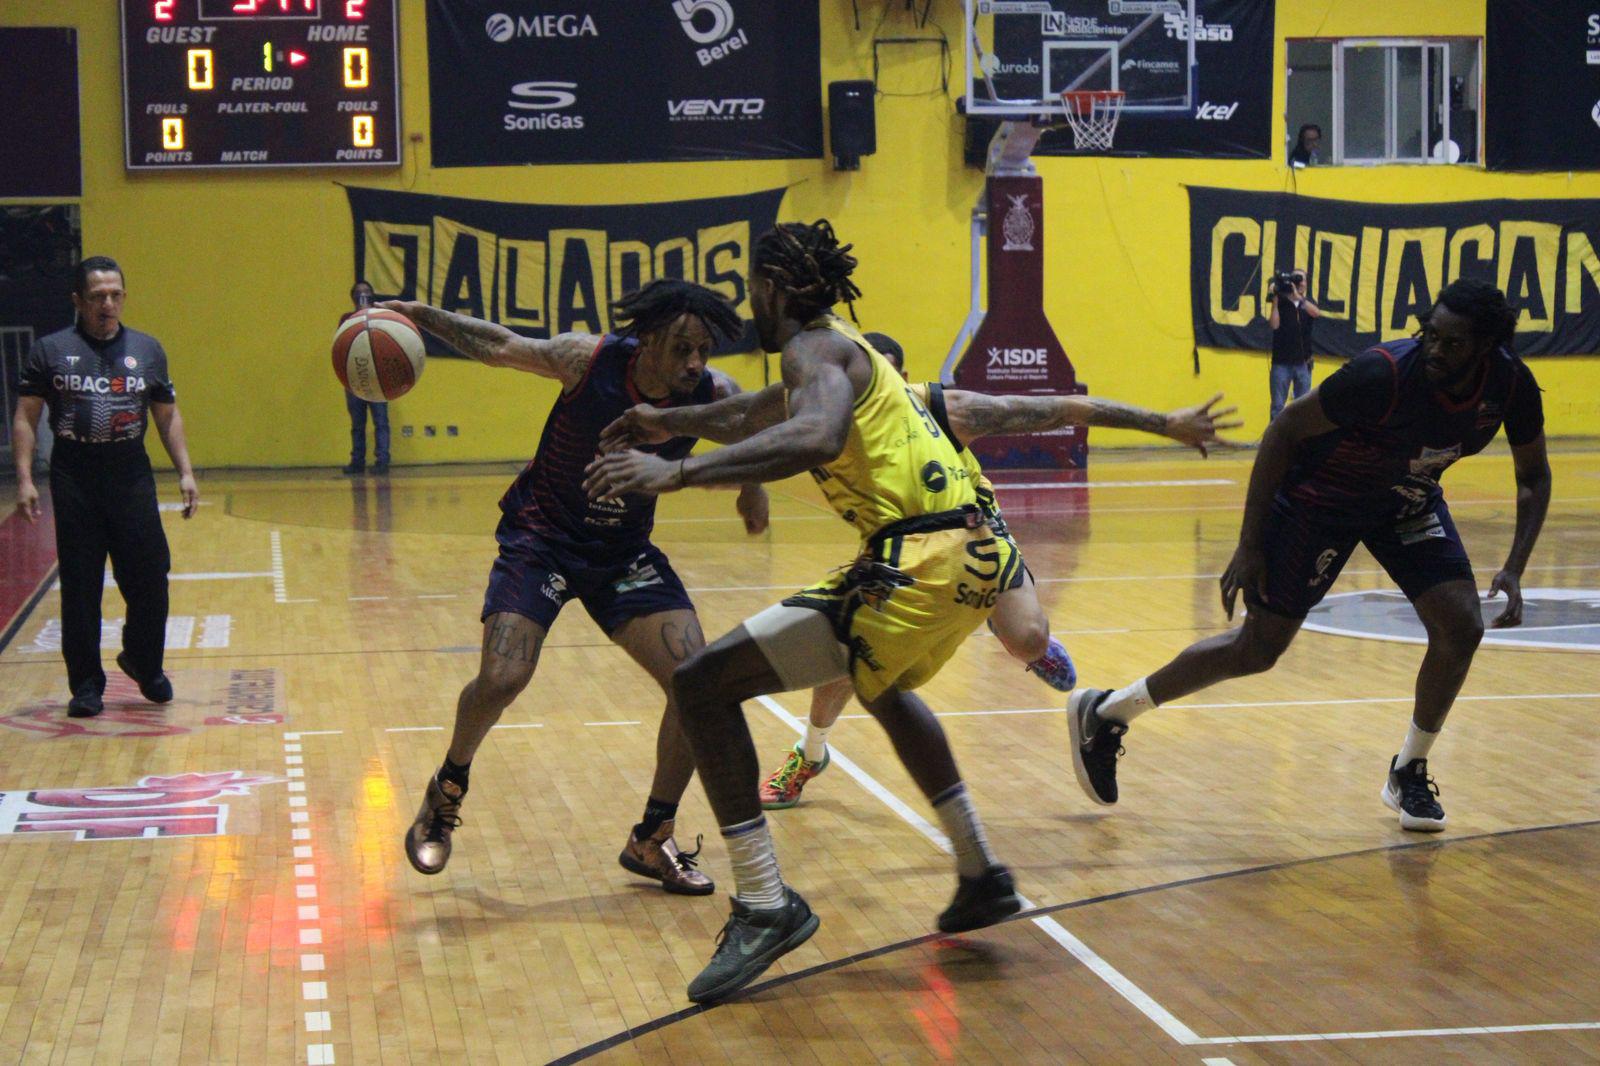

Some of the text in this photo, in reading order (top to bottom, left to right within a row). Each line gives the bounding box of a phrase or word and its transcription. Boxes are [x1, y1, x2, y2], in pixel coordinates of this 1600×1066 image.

[307, 25, 370, 43] HOME
[517, 14, 598, 38] MEGA
[146, 27, 217, 44] GUEST
[696, 28, 749, 67] Berel
[188, 49, 214, 90] 0
[343, 47, 369, 88] 0
[231, 77, 294, 91] PERIOD
[146, 103, 188, 115] FOULS
[217, 102, 308, 113] PLAYER-FOUL
[337, 101, 378, 112] FOULS
[667, 98, 765, 116] VENTO
[503, 112, 585, 130] SoniGas
[162, 117, 184, 150] 0
[352, 115, 374, 147] 0
[145, 151, 192, 163] POINTS
[221, 151, 268, 162] MATCH
[336, 149, 383, 160] POINTS
[1003, 348, 1047, 365] ISDE
